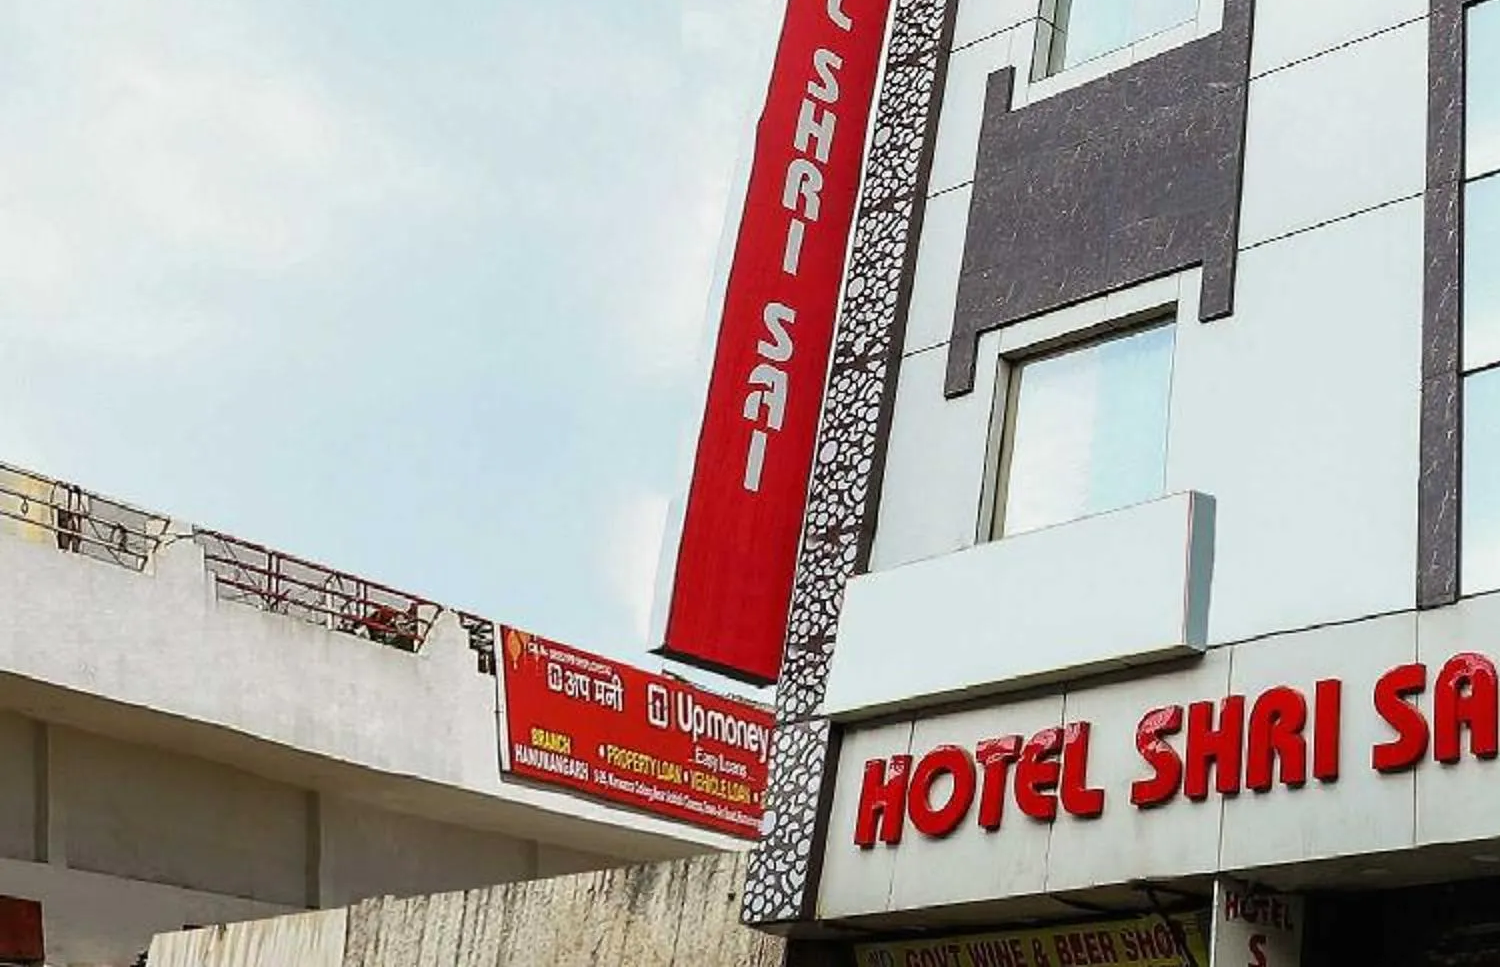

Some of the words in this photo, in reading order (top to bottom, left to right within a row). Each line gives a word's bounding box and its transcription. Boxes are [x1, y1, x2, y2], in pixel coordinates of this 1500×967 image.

[783, 47, 845, 276] SHRI
[743, 302, 797, 492] SAI
[606, 744, 656, 777] PROPERTY
[853, 721, 1105, 850] HOTEL
[1129, 678, 1342, 810] SHRI
